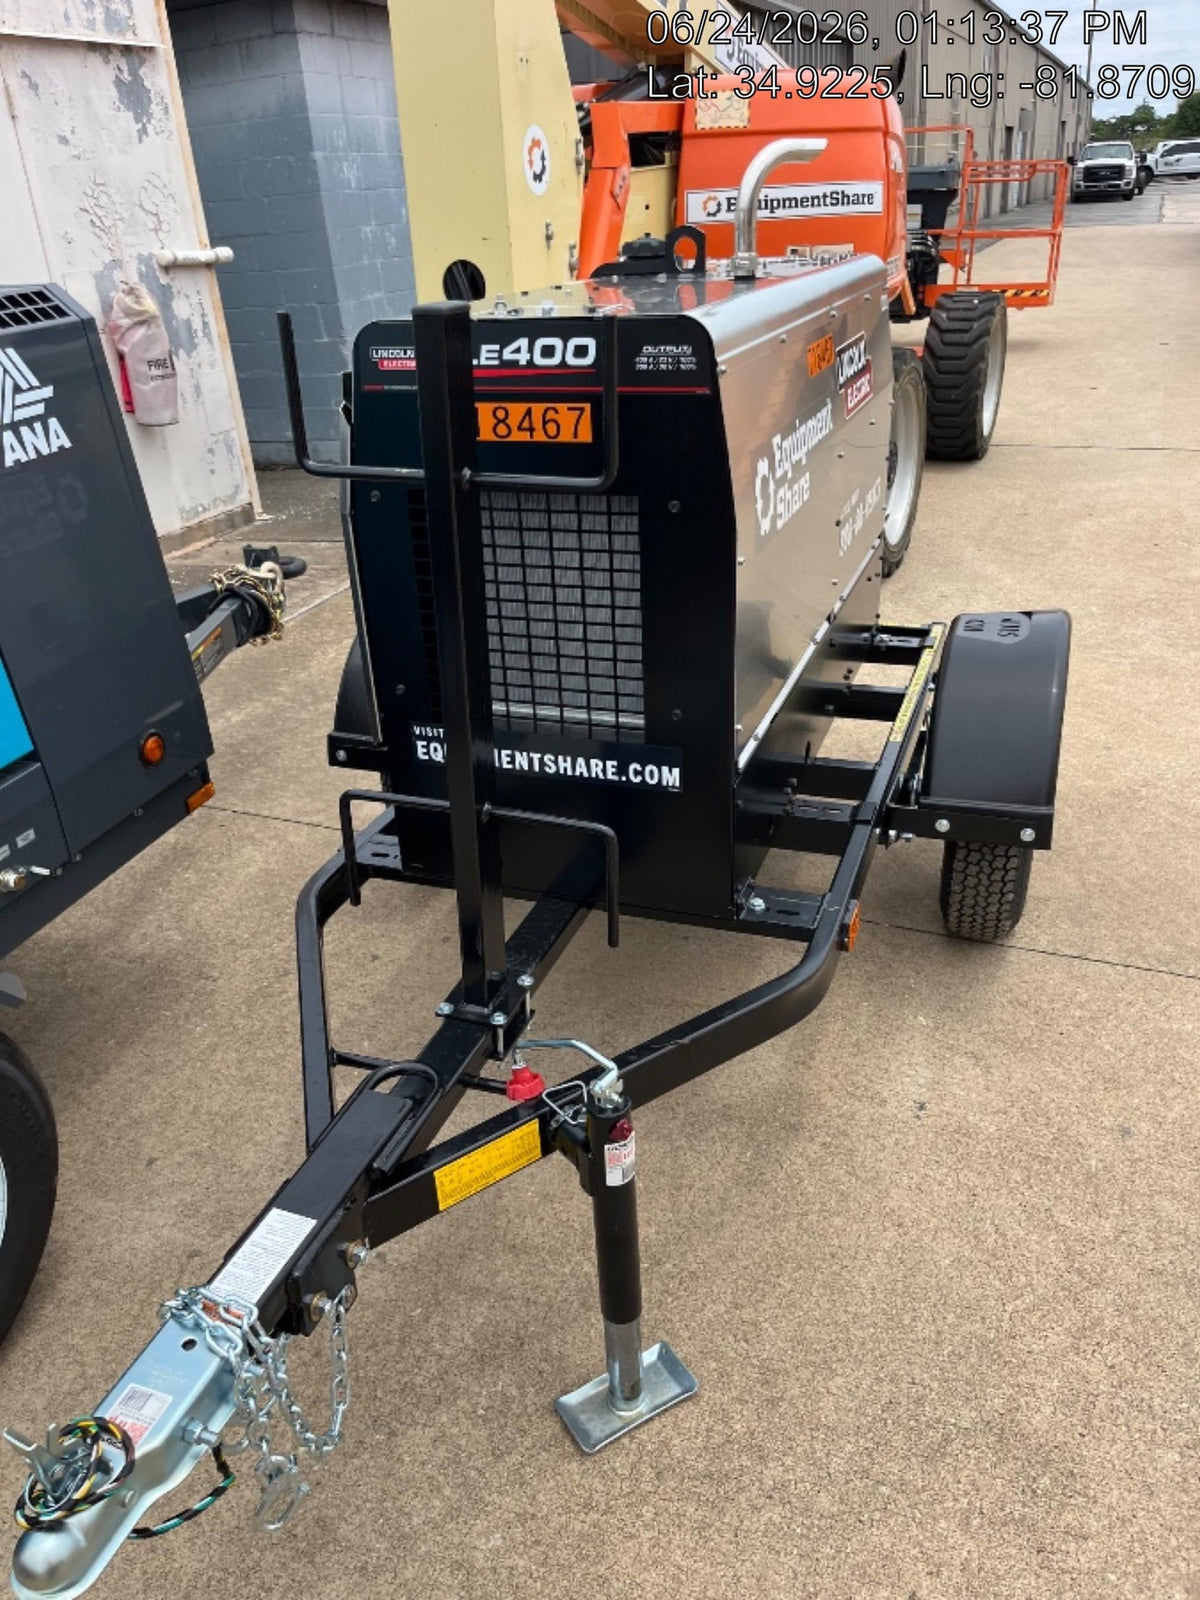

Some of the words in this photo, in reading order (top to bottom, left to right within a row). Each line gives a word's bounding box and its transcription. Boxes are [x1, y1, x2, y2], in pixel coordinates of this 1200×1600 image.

[725, 190, 874, 214] EipmentShare
[146, 358, 170, 372] FIRE
[472, 337, 597, 367] E400
[3, 417, 73, 468] ANA
[772, 398, 834, 479] Equipment
[777, 472, 811, 531] Share
[413, 725, 445, 738] VISIT
[416, 740, 681, 788] EQENTSHARE.COM
